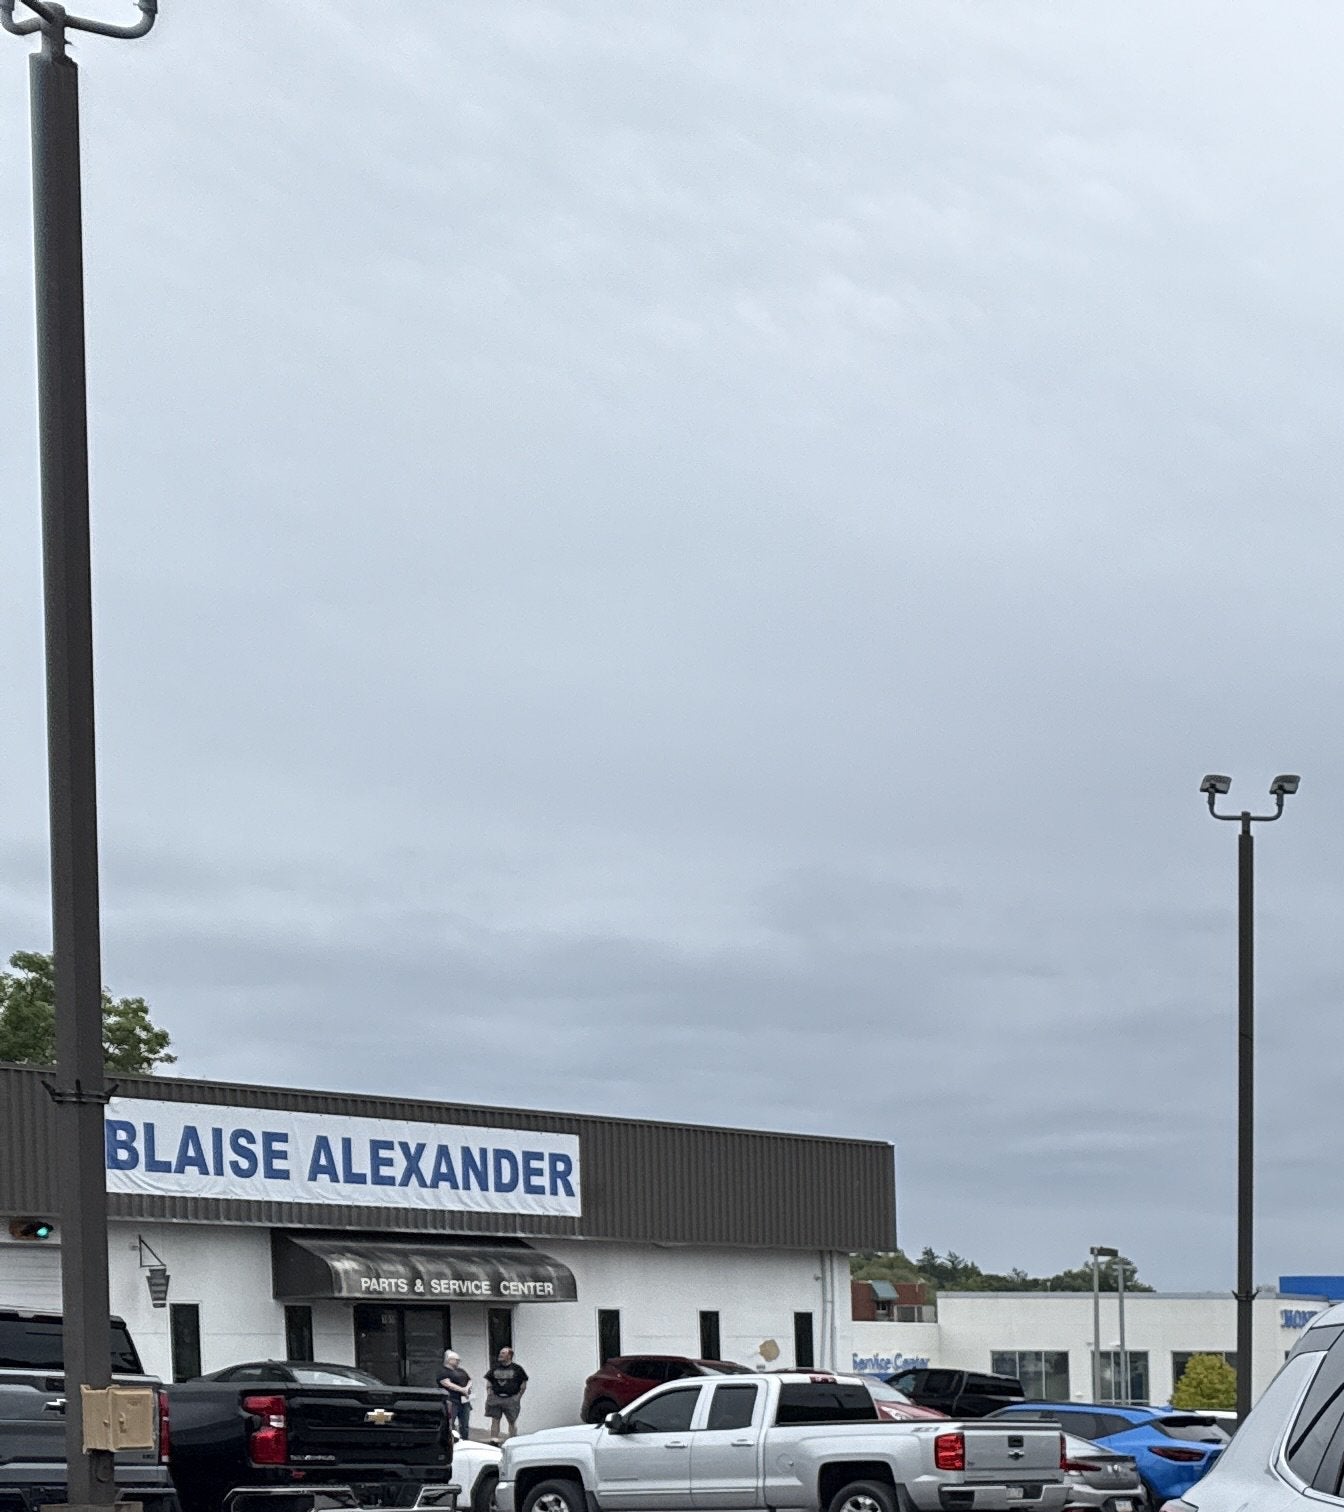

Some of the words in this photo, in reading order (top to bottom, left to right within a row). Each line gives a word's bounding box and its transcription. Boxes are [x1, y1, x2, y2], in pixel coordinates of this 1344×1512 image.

[105, 1119, 291, 1181] BLAISE
[307, 1135, 576, 1197] ALEXANDER
[361, 1278, 408, 1292] PARTS
[414, 1279, 425, 1293] &
[431, 1280, 491, 1294] SERVICE
[500, 1281, 554, 1295] CENTER
